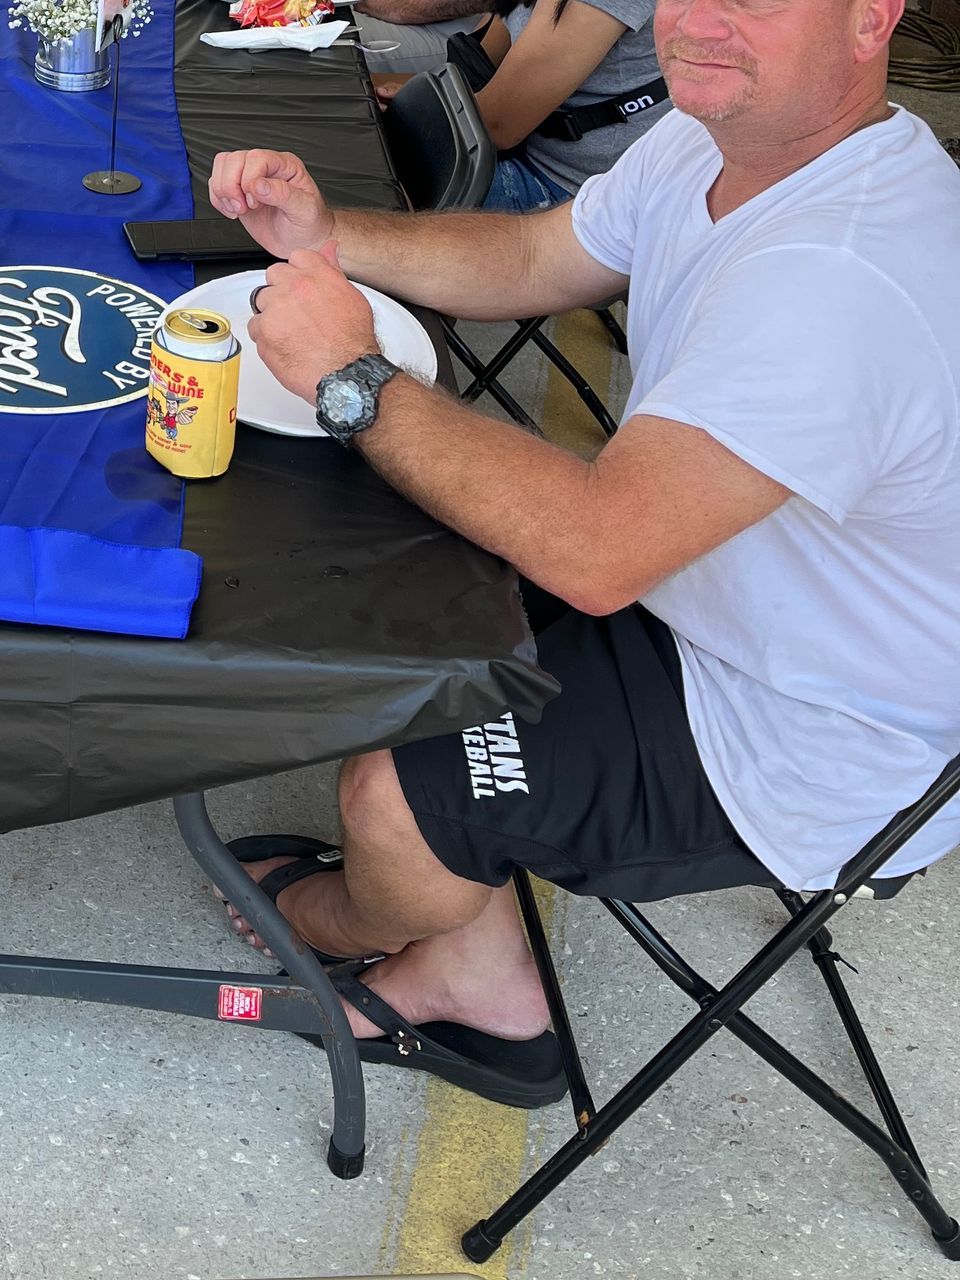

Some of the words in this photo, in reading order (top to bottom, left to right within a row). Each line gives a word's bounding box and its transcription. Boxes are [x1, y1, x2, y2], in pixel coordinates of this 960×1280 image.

[619, 94, 655, 115] on
[102, 360, 151, 390] BY
[151, 354, 184, 383] NERS
[187, 376, 199, 387] &
[484, 712, 530, 794] TANS
